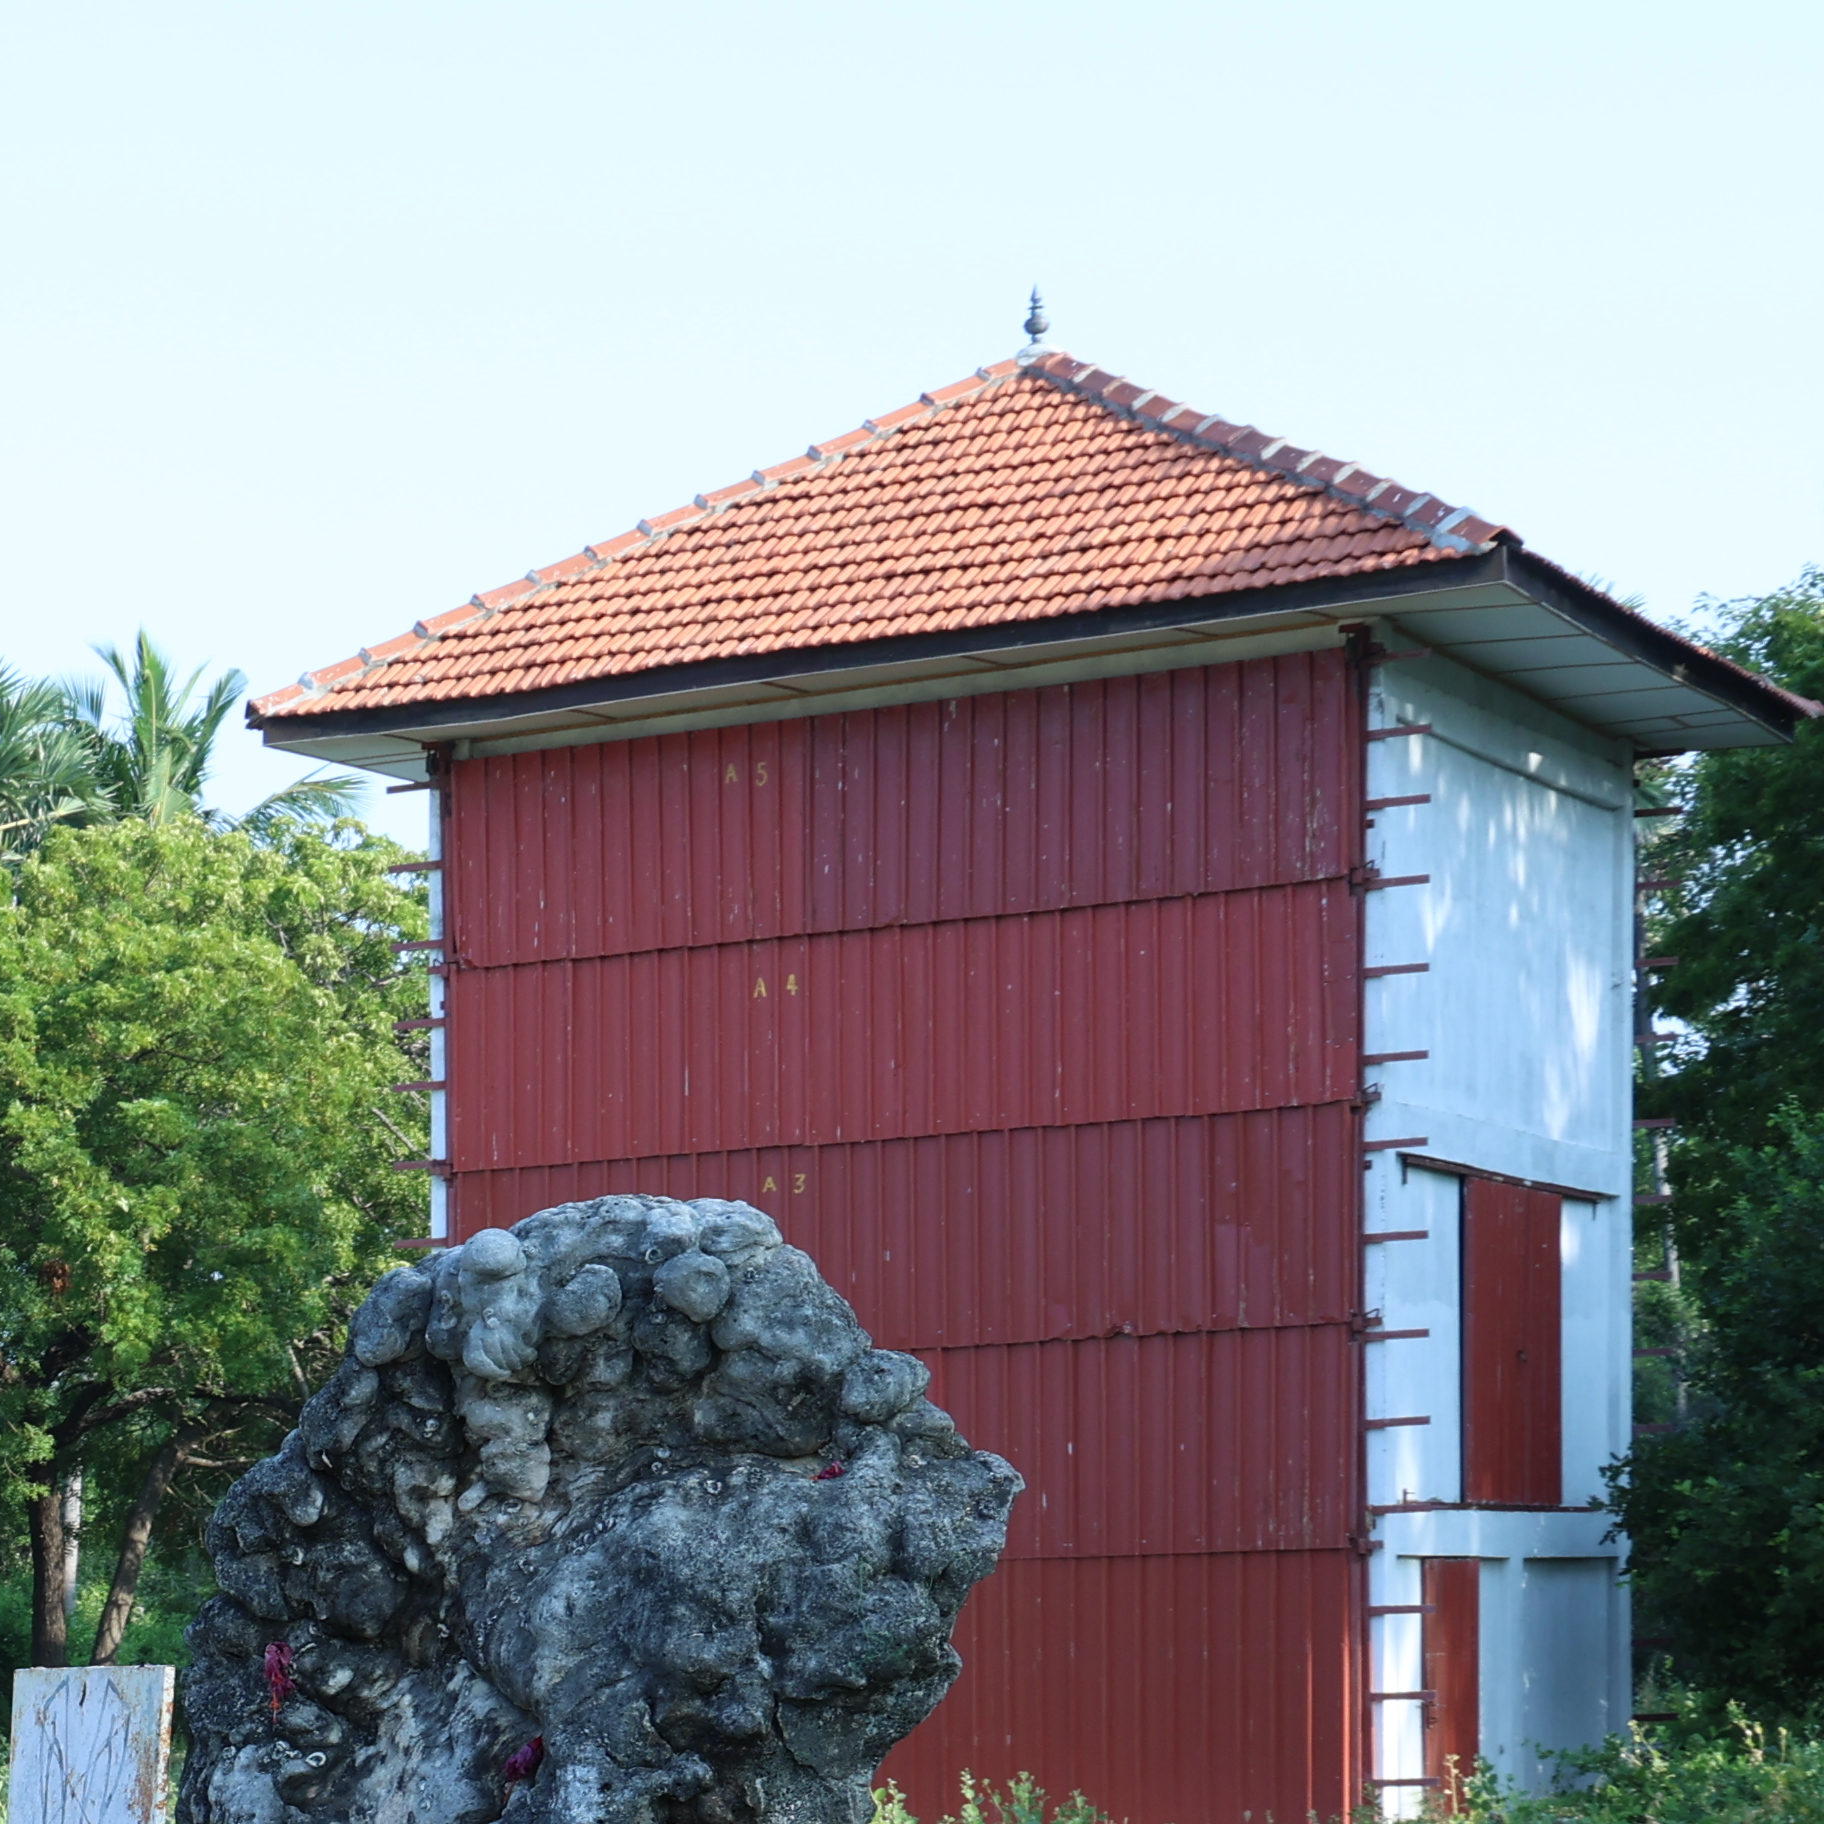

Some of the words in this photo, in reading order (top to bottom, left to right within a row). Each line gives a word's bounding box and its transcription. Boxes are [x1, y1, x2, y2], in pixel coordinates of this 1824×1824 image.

[725, 763, 738, 784] A
[756, 761, 768, 787] 5
[753, 977, 768, 998] A
[786, 973, 799, 996] 4
[762, 1176, 777, 1193] A
[793, 1173, 807, 1194] 3
